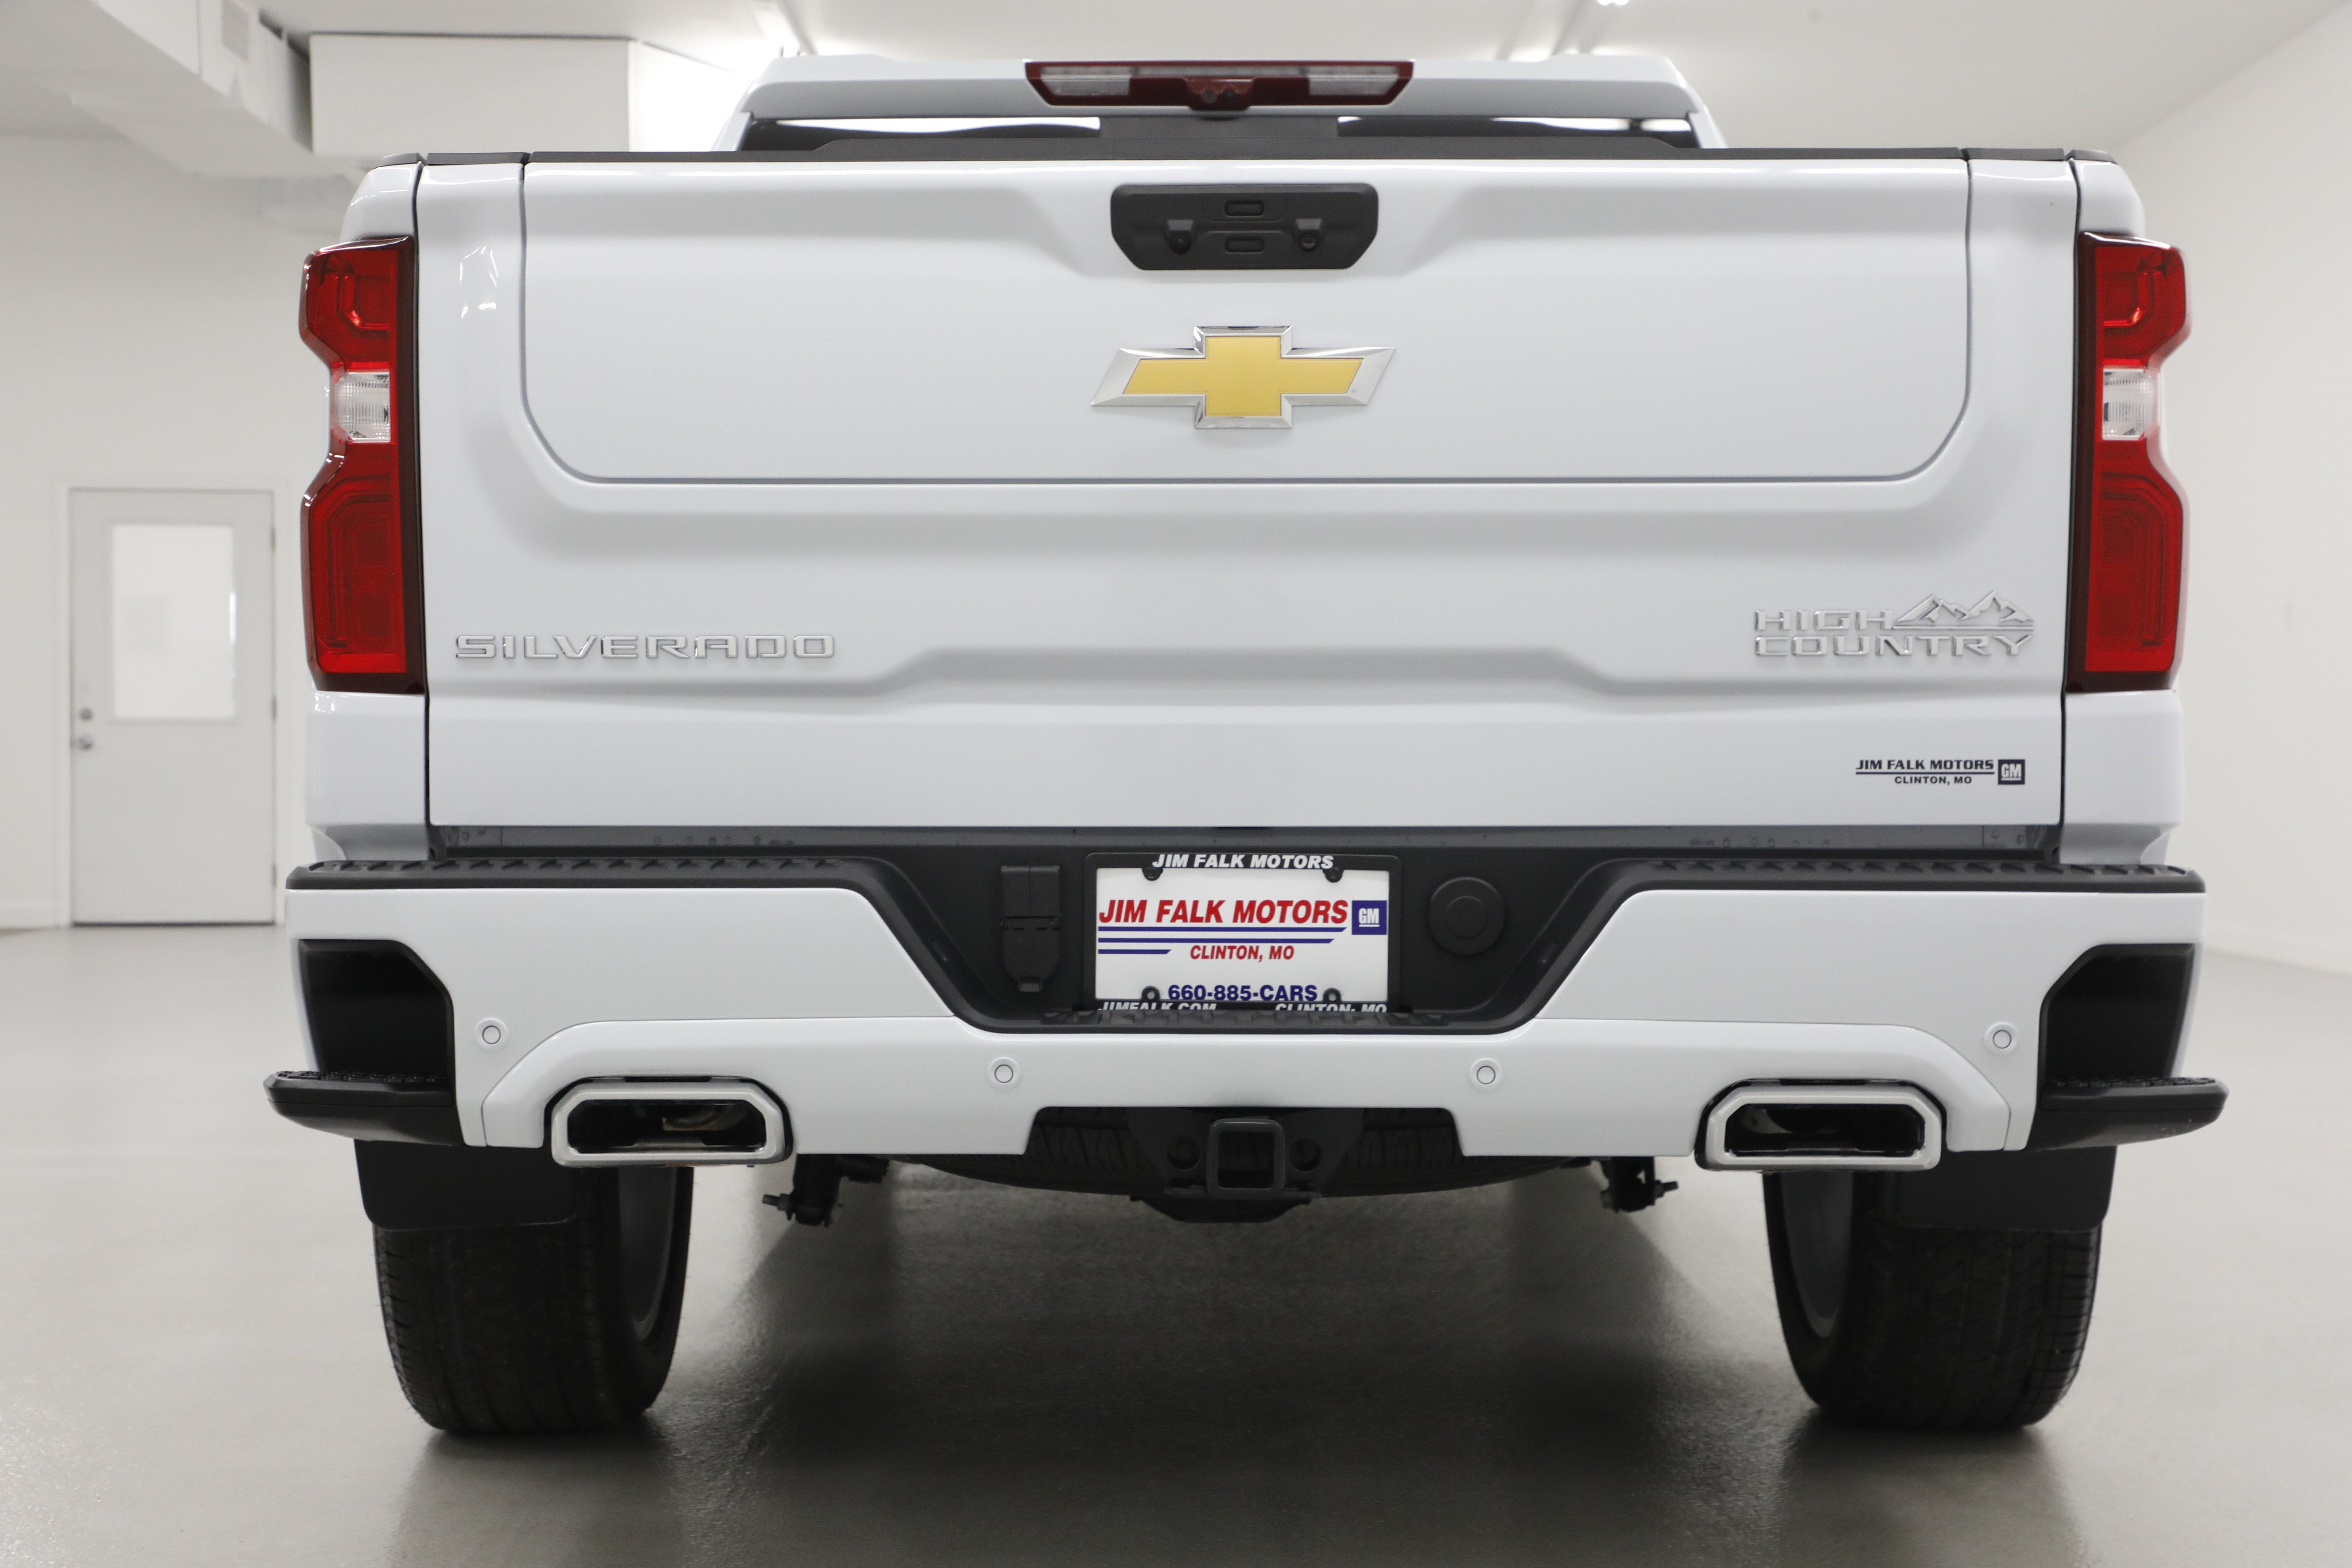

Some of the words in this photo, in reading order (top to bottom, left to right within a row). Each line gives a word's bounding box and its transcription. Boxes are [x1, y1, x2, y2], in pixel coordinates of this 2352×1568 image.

[1754, 610, 1893, 630] HIGH
[455, 635, 835, 659] SILVERADO
[1755, 635, 2033, 656] COUNTRY
[1856, 760, 1882, 770] JIM
[1887, 760, 1925, 770] FALK
[1930, 760, 1994, 770] MOTORS
[2001, 763, 2022, 778] GM
[1894, 776, 1950, 786] CLINTON,
[1152, 854, 1188, 868] JIM
[1193, 854, 1245, 868] FALK
[1250, 855, 1334, 869] MOTORS
[1099, 900, 1147, 923] JIM
[1156, 900, 1226, 923] FALK
[1232, 900, 1348, 924] MOTORS
[1358, 907, 1380, 924] GM
[1190, 945, 1263, 962] CLINTON,
[1268, 945, 1294, 960] MO
[1168, 984, 1318, 1001] 660-885-CARS
[1361, 1004, 1388, 1013] MO
